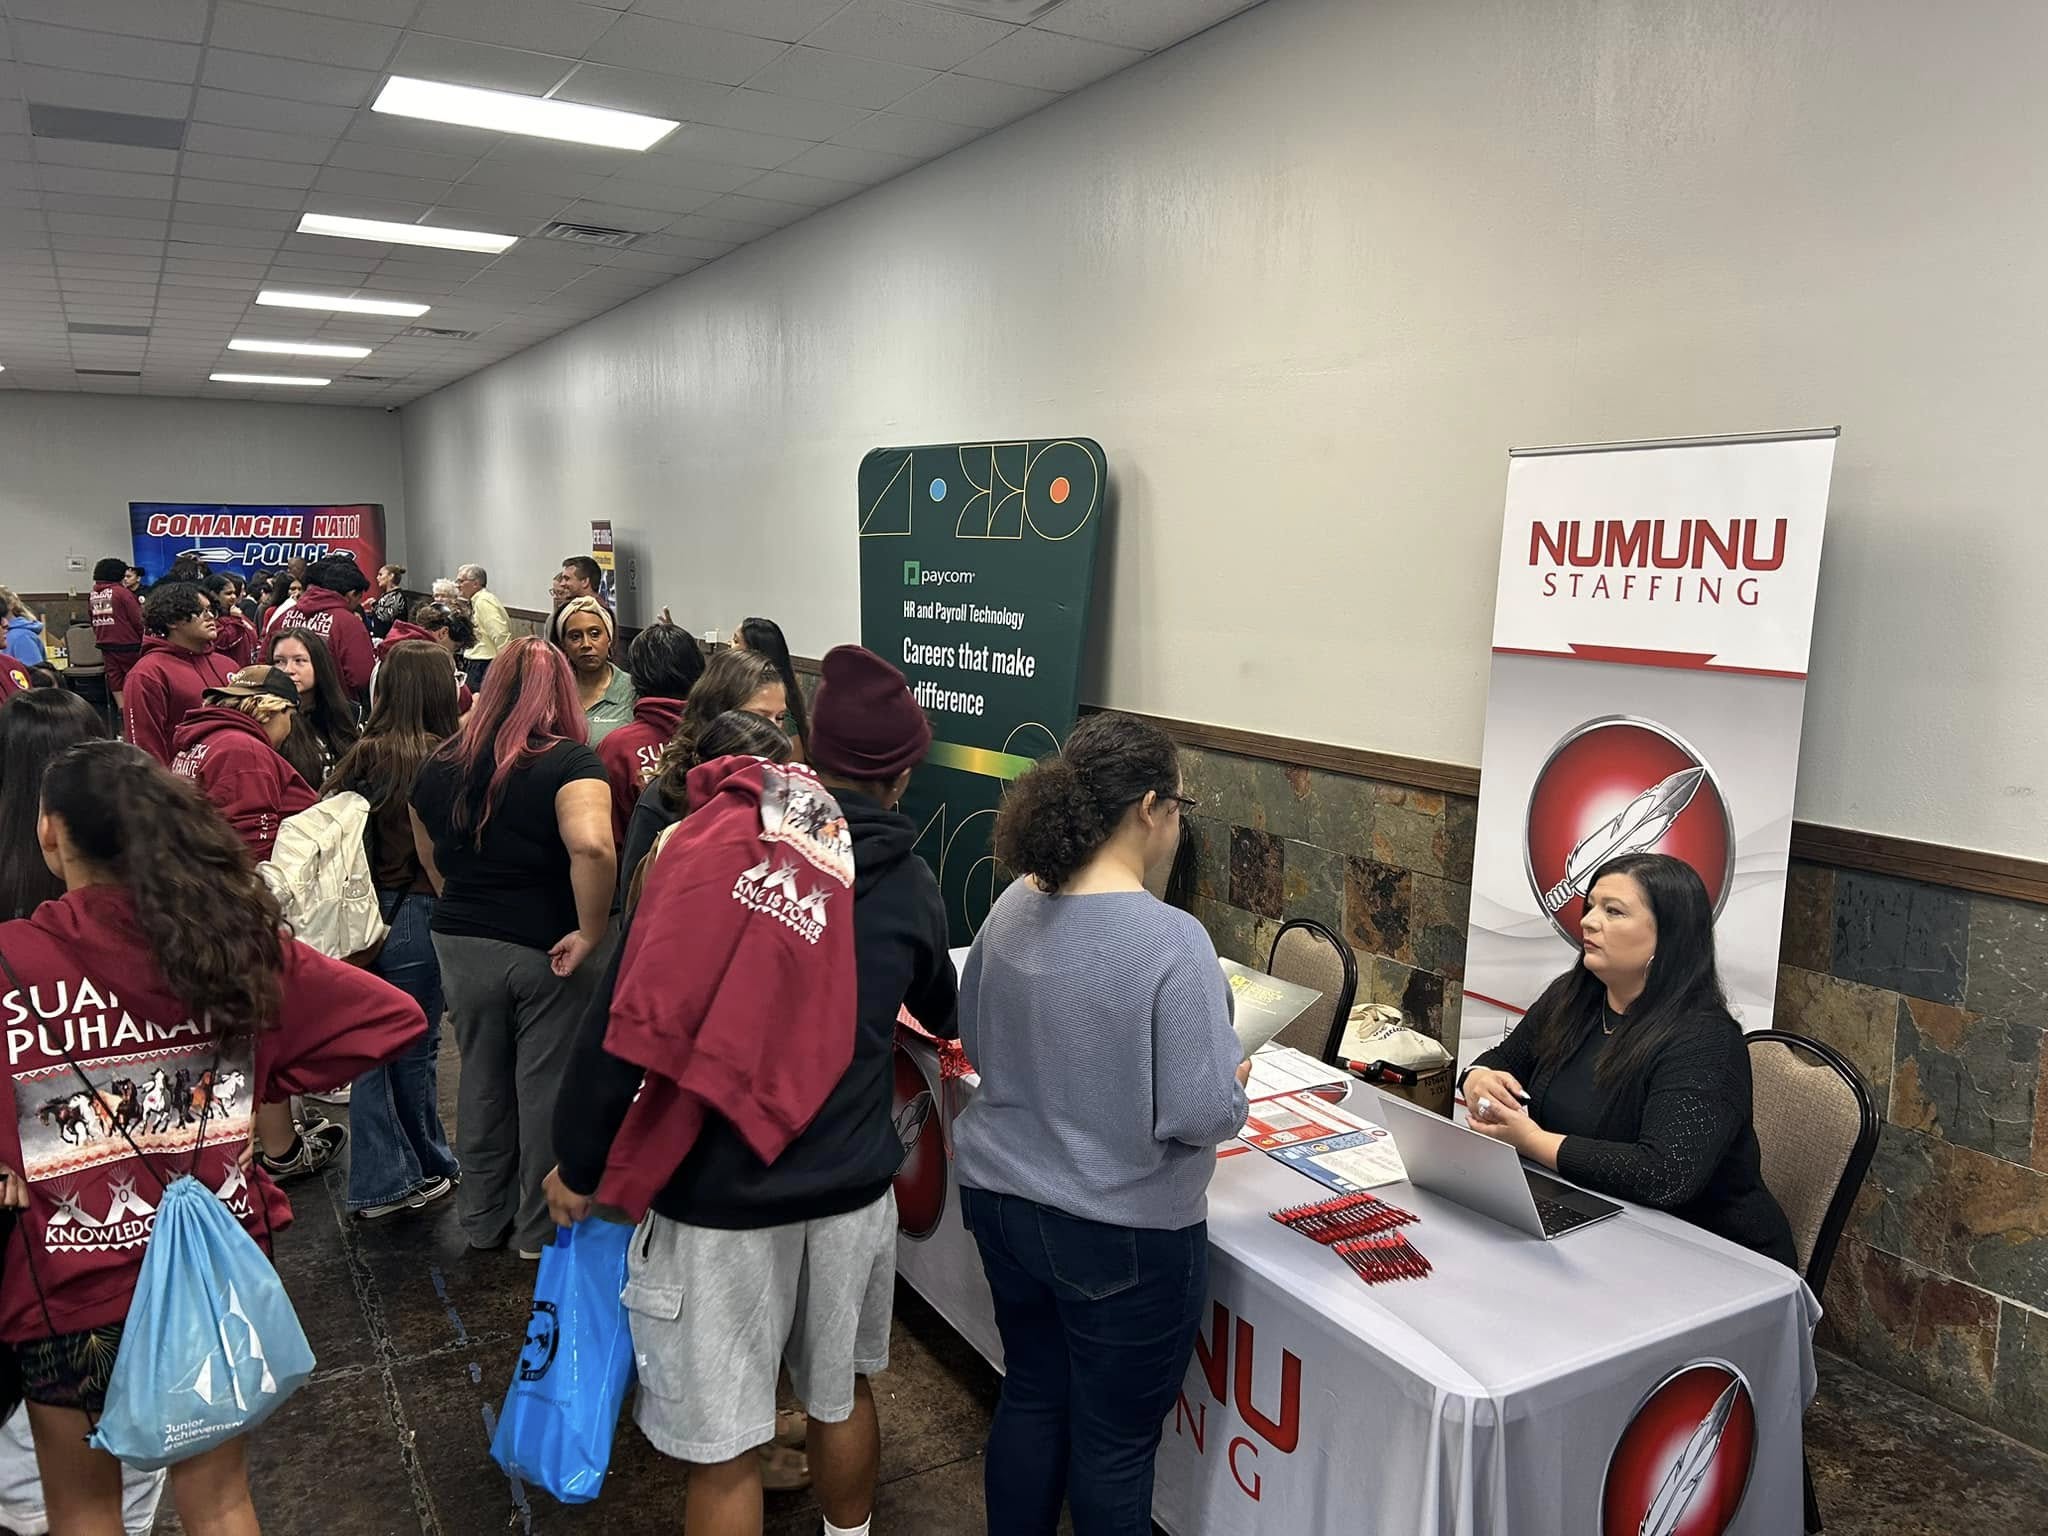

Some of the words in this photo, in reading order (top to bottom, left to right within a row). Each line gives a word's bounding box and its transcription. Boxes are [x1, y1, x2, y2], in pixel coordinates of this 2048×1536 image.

[147, 513, 303, 538] COMANCHE
[1529, 518, 1788, 571] NUMUNU
[921, 570, 975, 586] paycom
[1543, 572, 1759, 606] STAFFING
[903, 600, 916, 618] HR
[917, 602, 934, 619] and
[935, 602, 967, 623] Payroll
[969, 604, 1025, 630] Technology
[903, 636, 955, 668] Careers
[958, 642, 989, 672] that
[992, 648, 1036, 677] make
[914, 680, 984, 716] difference
[765, 891, 784, 909] IS
[165, 1418, 205, 1434] Junior
